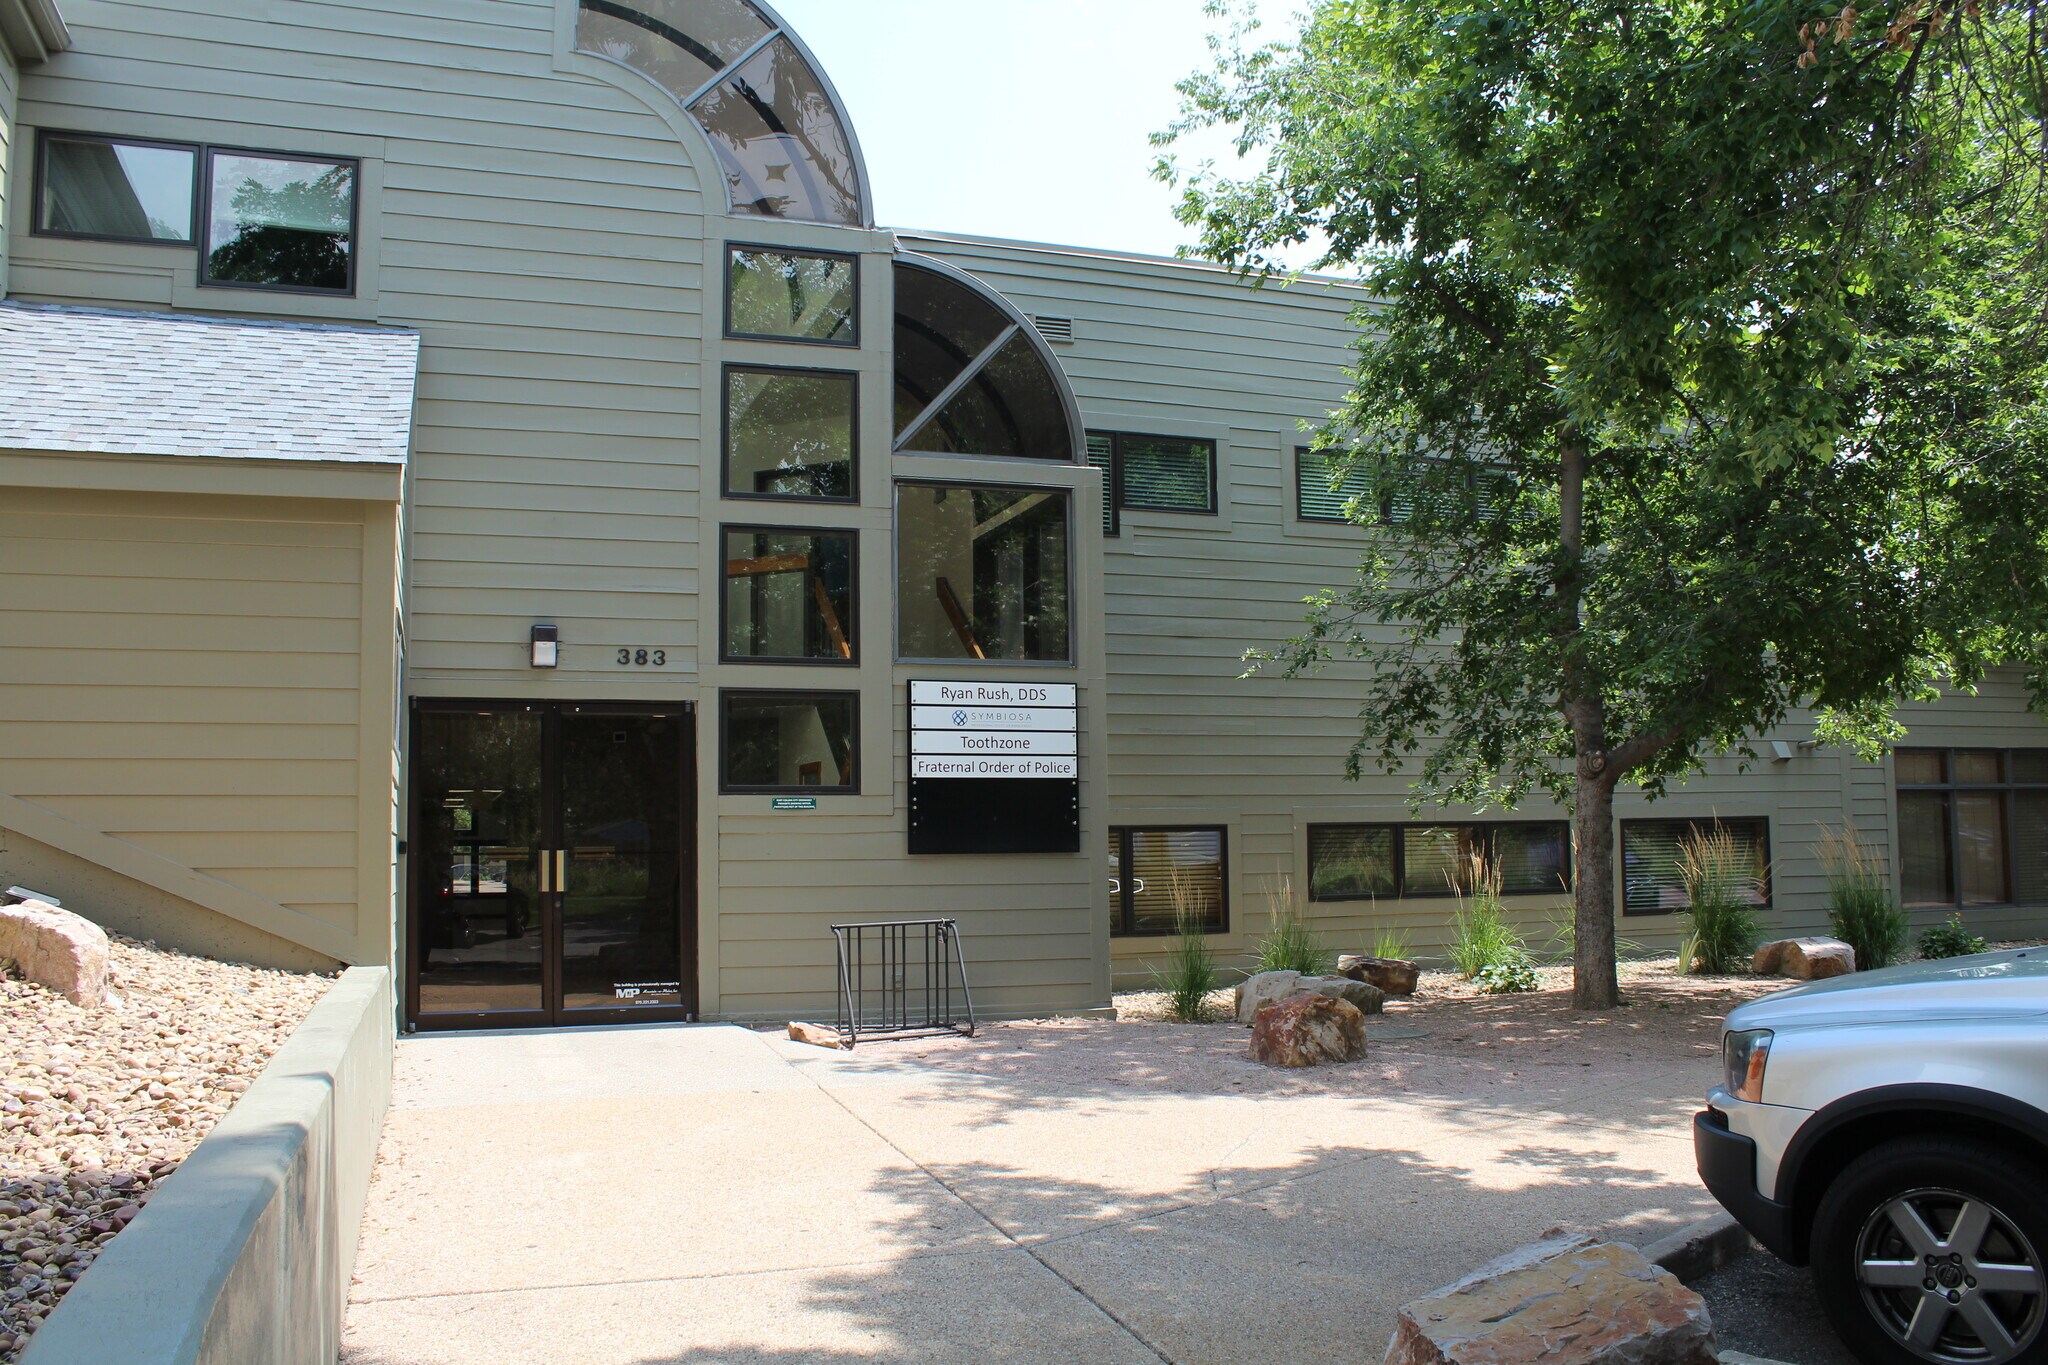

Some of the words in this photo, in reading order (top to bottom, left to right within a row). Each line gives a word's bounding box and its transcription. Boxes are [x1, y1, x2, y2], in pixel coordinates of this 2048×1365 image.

[617, 648, 666, 666] 383
[941, 686, 973, 702] Ryan
[977, 687, 1014, 702] Rush,
[1018, 688, 1047, 701] DDS
[971, 712, 1032, 721] SYMBIOSA
[960, 736, 1031, 749] Toothzone
[918, 760, 975, 773] Fraternal
[979, 761, 1015, 773] Order
[1018, 761, 1031, 773] of
[1035, 761, 1071, 774] Police
